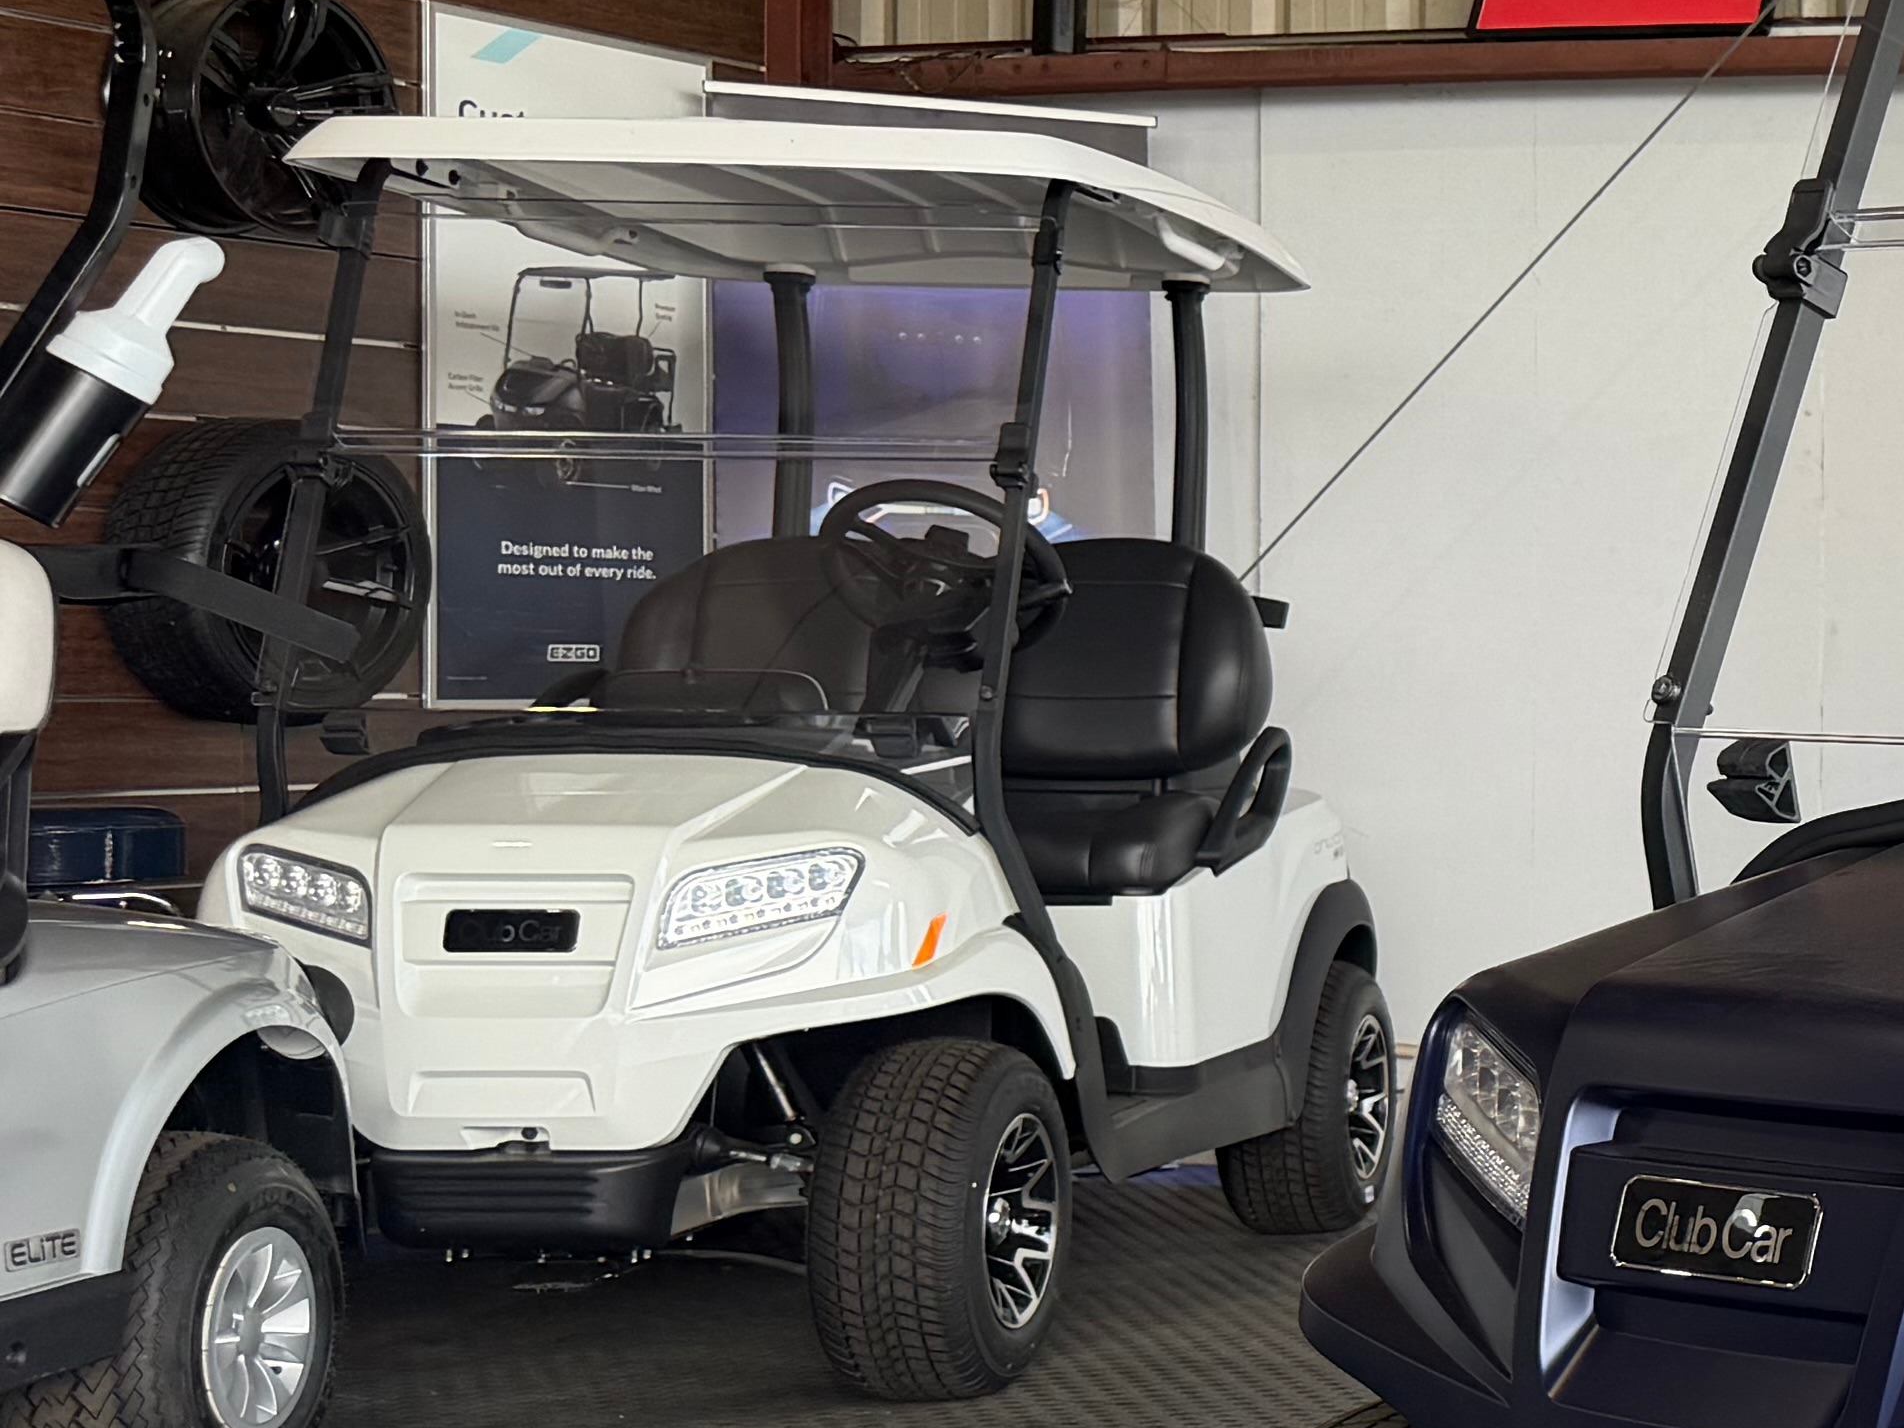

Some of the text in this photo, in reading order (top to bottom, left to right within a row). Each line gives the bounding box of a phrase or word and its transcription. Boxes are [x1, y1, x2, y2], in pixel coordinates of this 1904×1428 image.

[501, 540, 654, 561] Designed to make the
[497, 563, 657, 580] most out of every ride.
[549, 646, 599, 660] EZGO
[1635, 1198, 1793, 1264] Club Car
